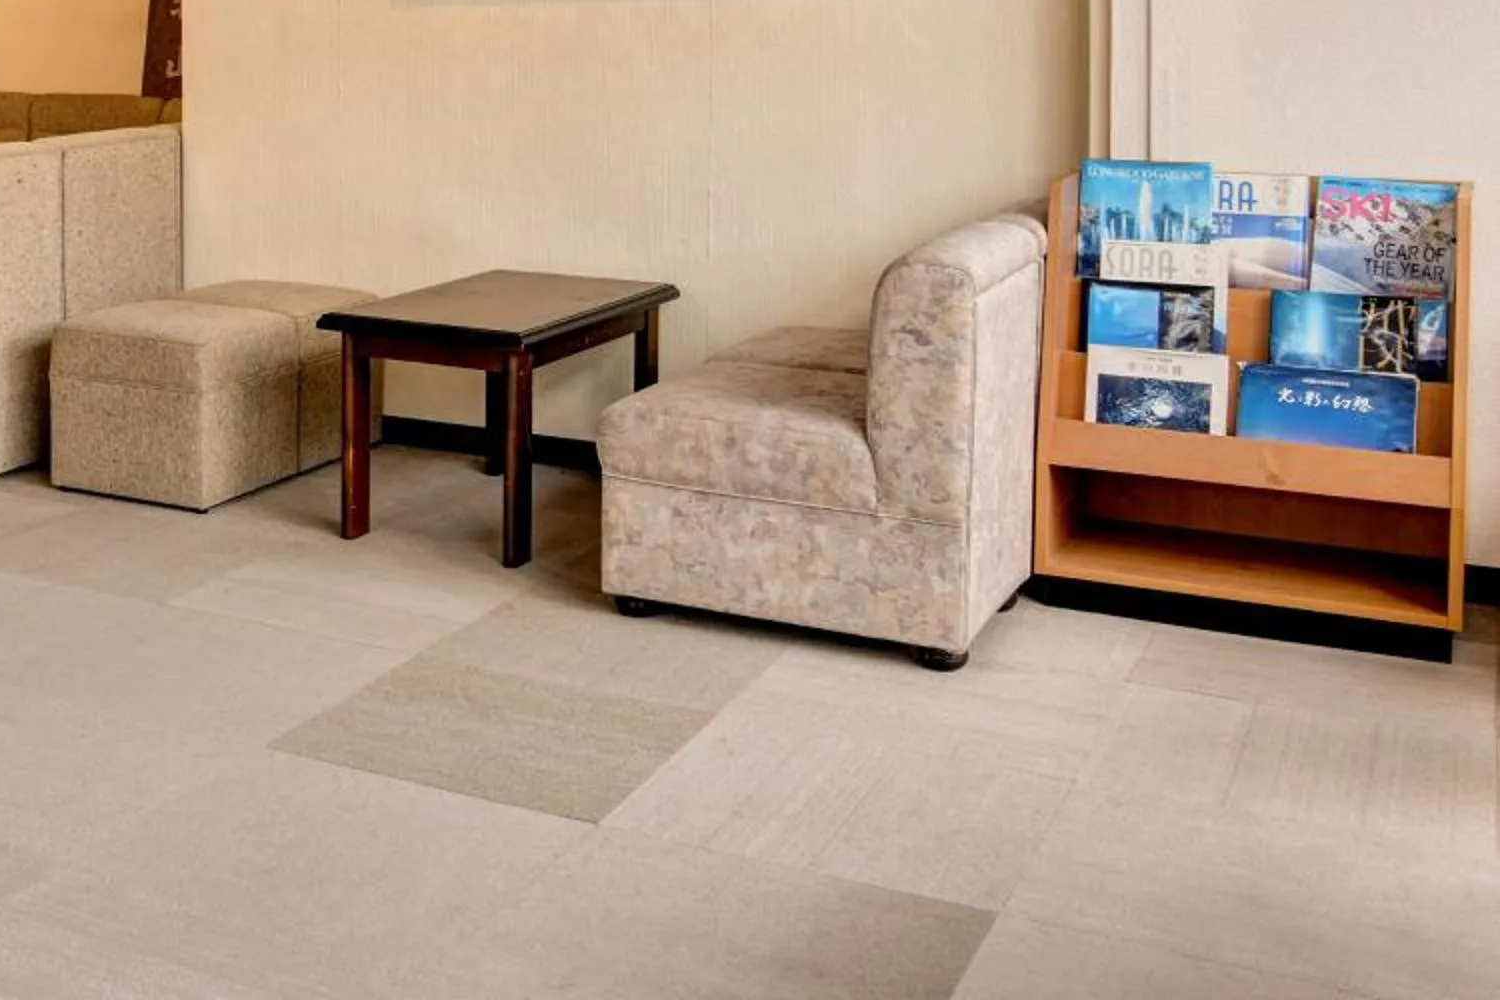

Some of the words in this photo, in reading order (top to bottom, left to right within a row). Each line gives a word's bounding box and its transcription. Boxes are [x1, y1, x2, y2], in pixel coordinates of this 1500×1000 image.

[1218, 179, 1257, 212] RA
[1320, 186, 1397, 223] SKI
[1373, 241, 1419, 261] GEAR
[1423, 244, 1446, 263] OF
[1364, 257, 1397, 278] THE
[1400, 259, 1445, 281] YEAR
